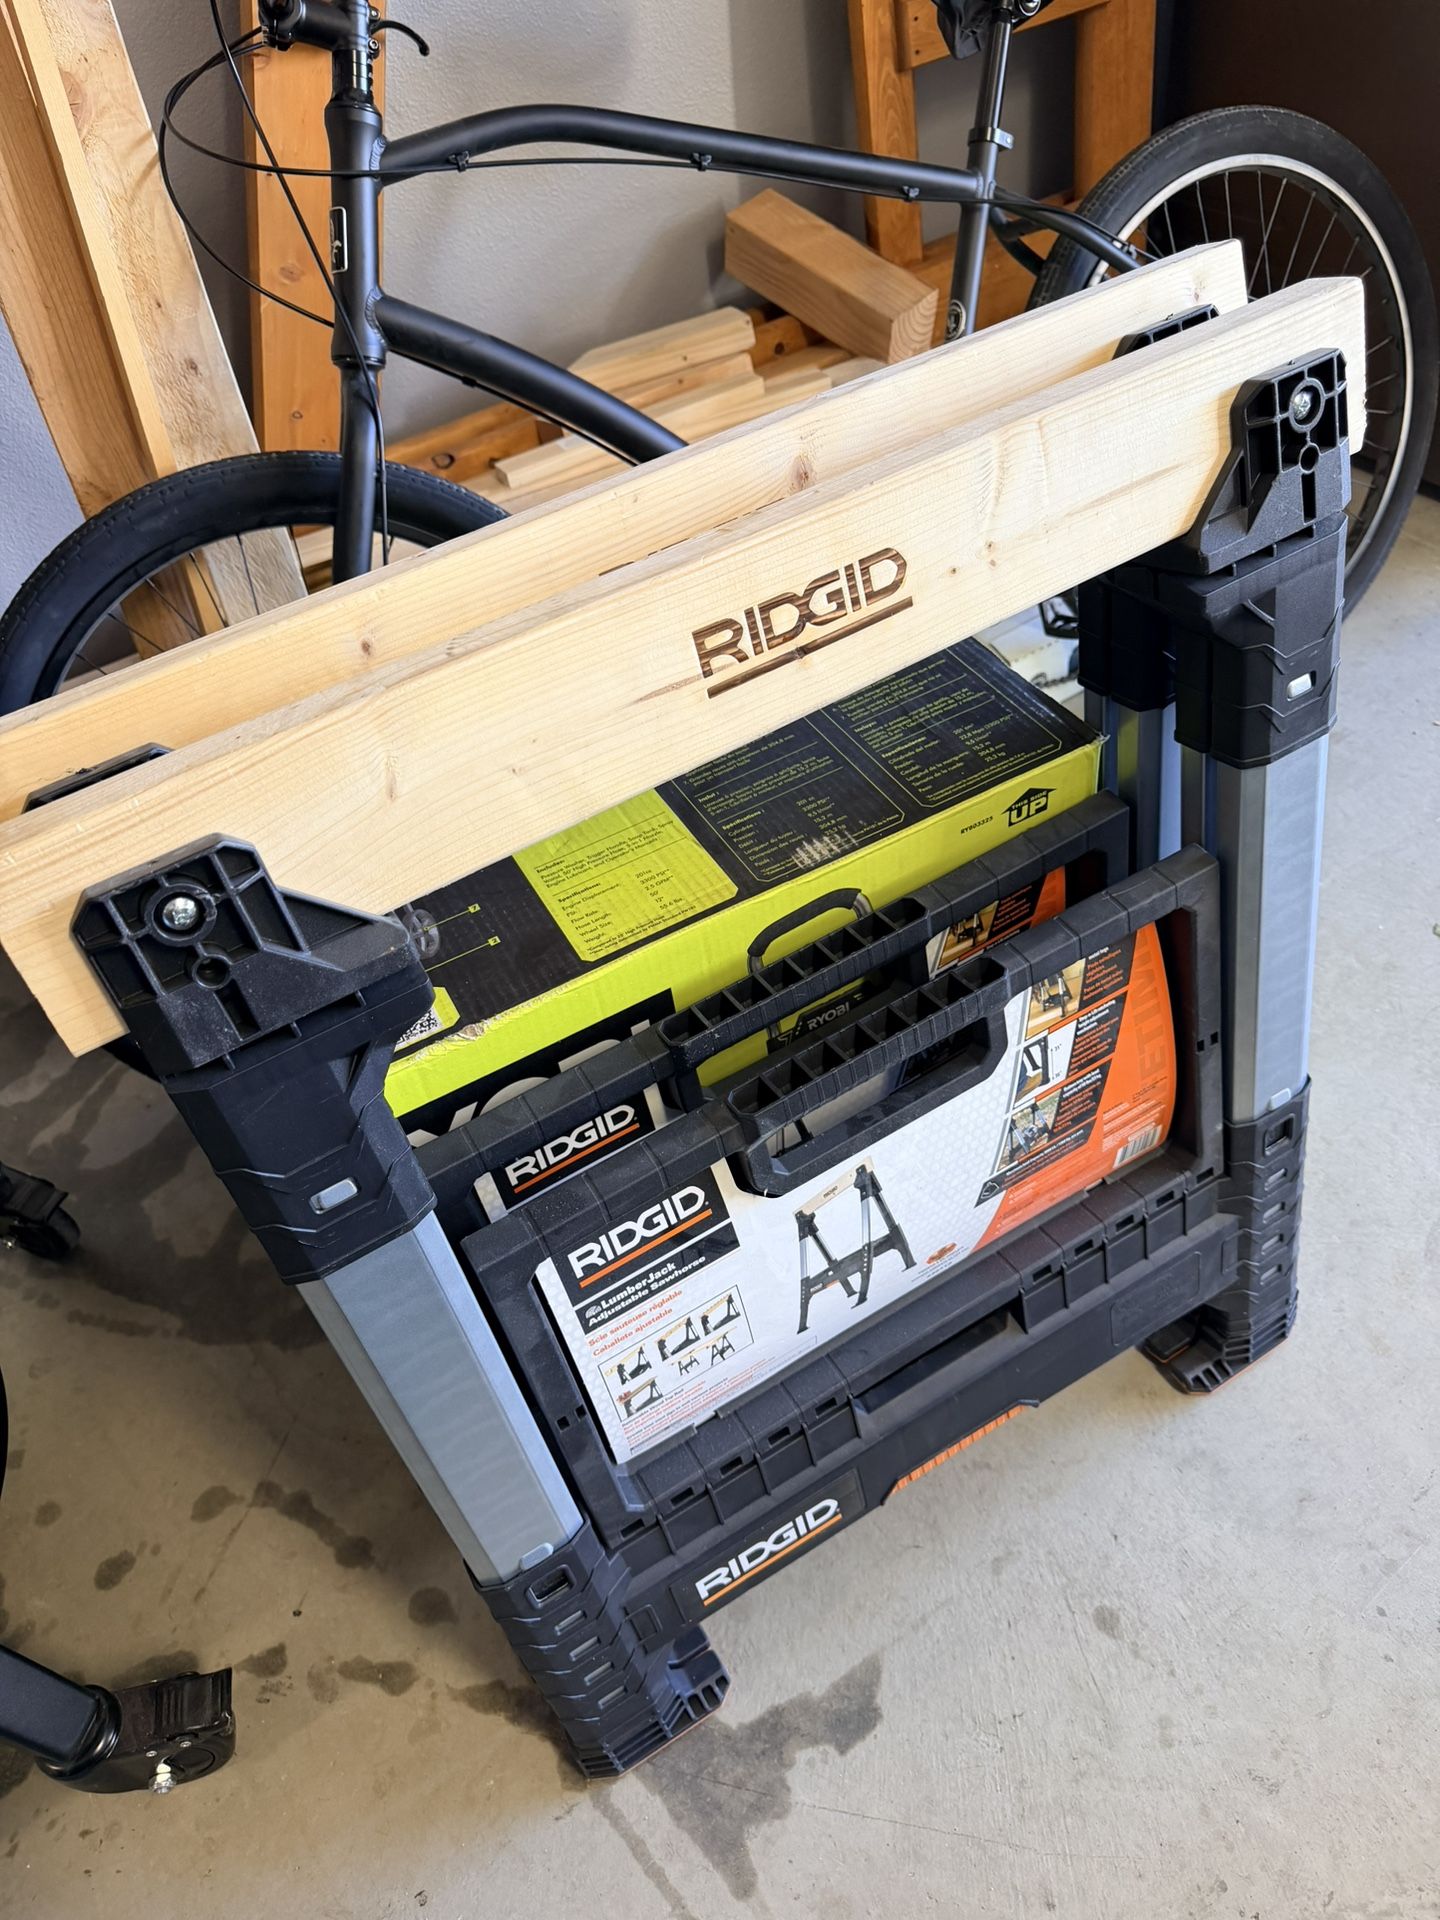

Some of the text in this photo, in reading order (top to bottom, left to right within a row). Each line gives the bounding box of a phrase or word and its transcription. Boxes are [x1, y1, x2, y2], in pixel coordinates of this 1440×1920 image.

[692, 547, 907, 679] RIDGID
[1011, 796, 1047, 823] UP
[806, 1001, 851, 1031] RYOBI
[505, 1104, 636, 1187] RIDGID
[567, 1186, 708, 1279] RIDGID
[588, 1256, 706, 1328] Adjustable Sawhorse
[600, 1261, 677, 1311] LumberJack
[695, 1497, 840, 1600] RIDGID
